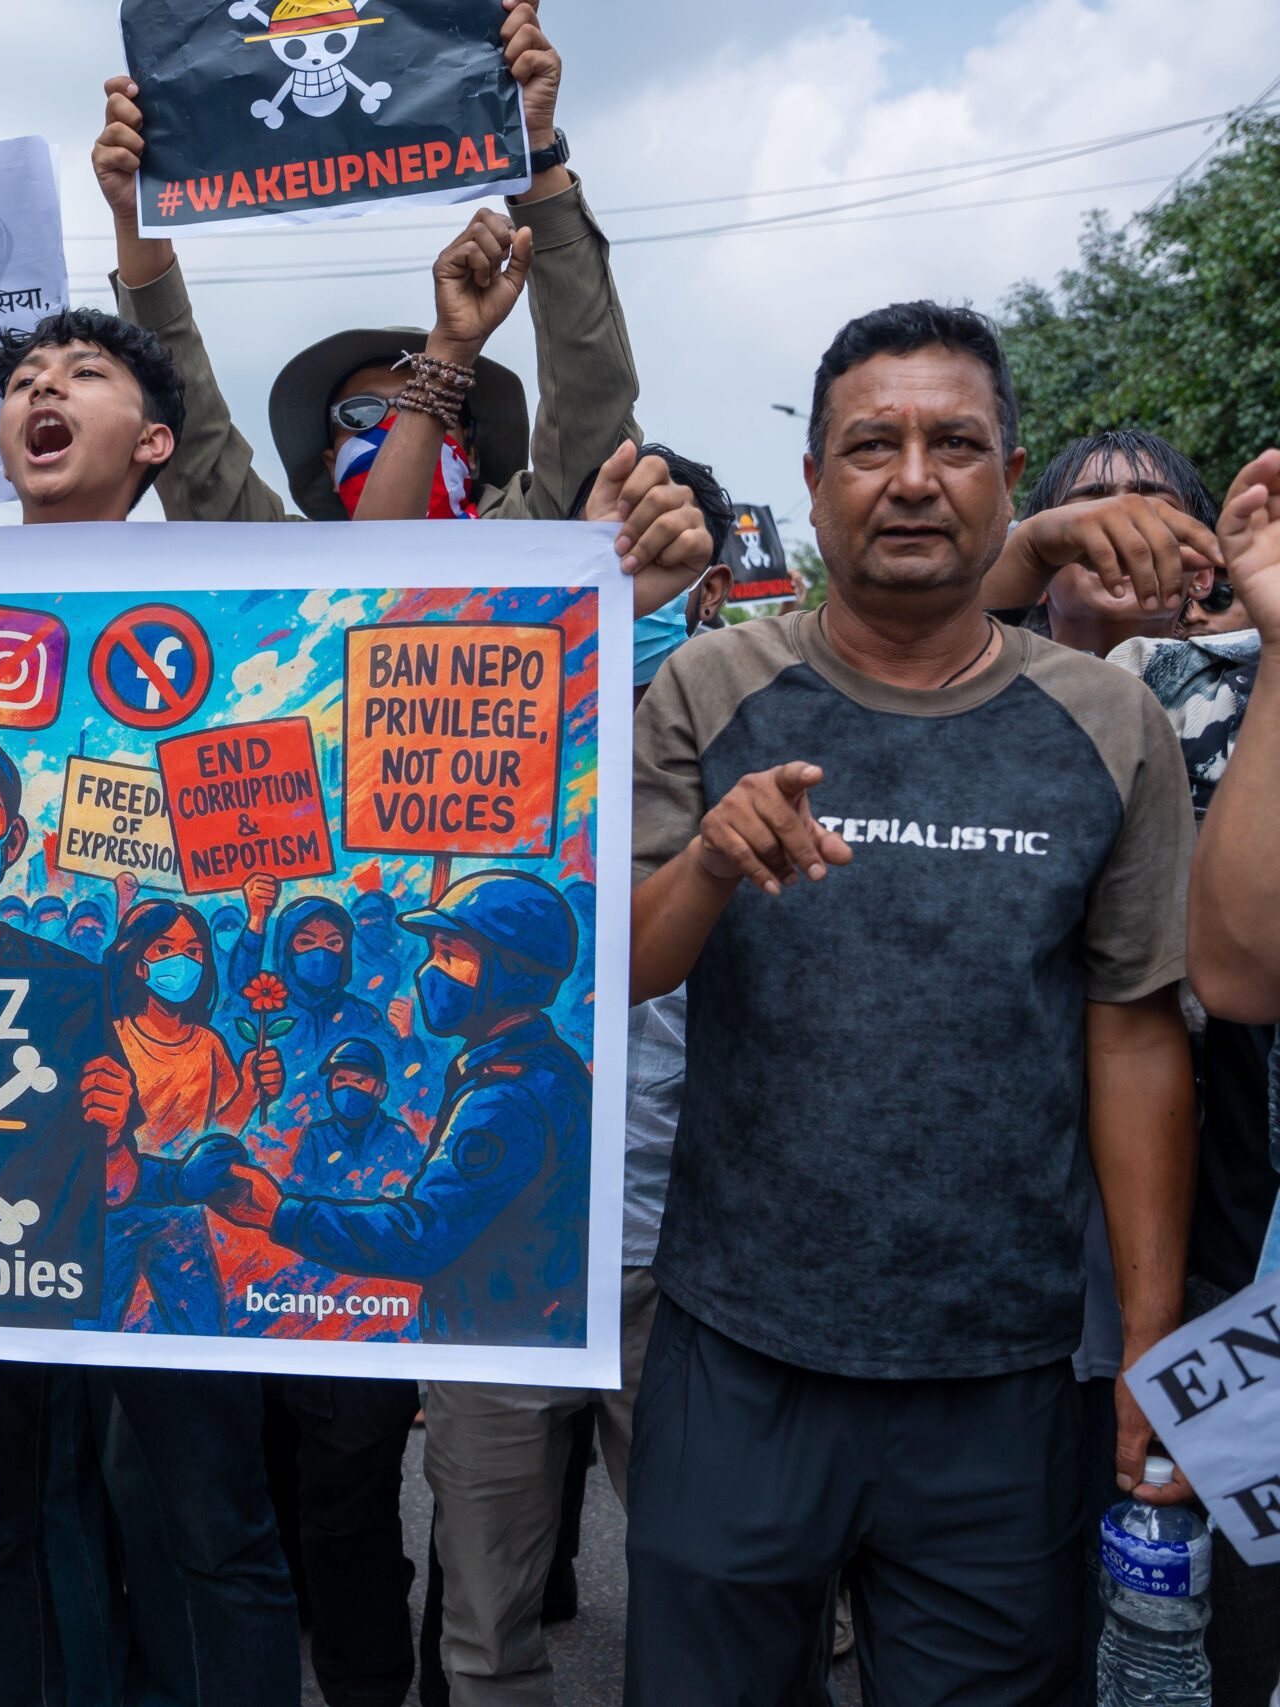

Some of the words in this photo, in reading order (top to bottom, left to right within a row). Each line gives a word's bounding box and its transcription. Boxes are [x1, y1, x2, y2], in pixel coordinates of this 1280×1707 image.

[158, 134, 509, 217] #WAKEUPNEPAL
[369, 643, 439, 688] BAN
[450, 643, 544, 690] NEPO
[365, 697, 548, 744] PRIVILEGE,
[197, 737, 271, 778] END
[381, 746, 442, 786] NOT
[450, 749, 521, 787] OUR
[77, 774, 170, 818] FREED
[178, 768, 313, 819] CORRUPTION
[373, 792, 515, 834] VOICES
[112, 815, 143, 835] OF
[238, 813, 260, 837] &
[818, 816, 1050, 855] TERIALISTIC
[190, 830, 320, 879] NEPOTISM
[245, 1285, 409, 1321] bcanp.com
[1151, 1581, 1169, 1591] 99
